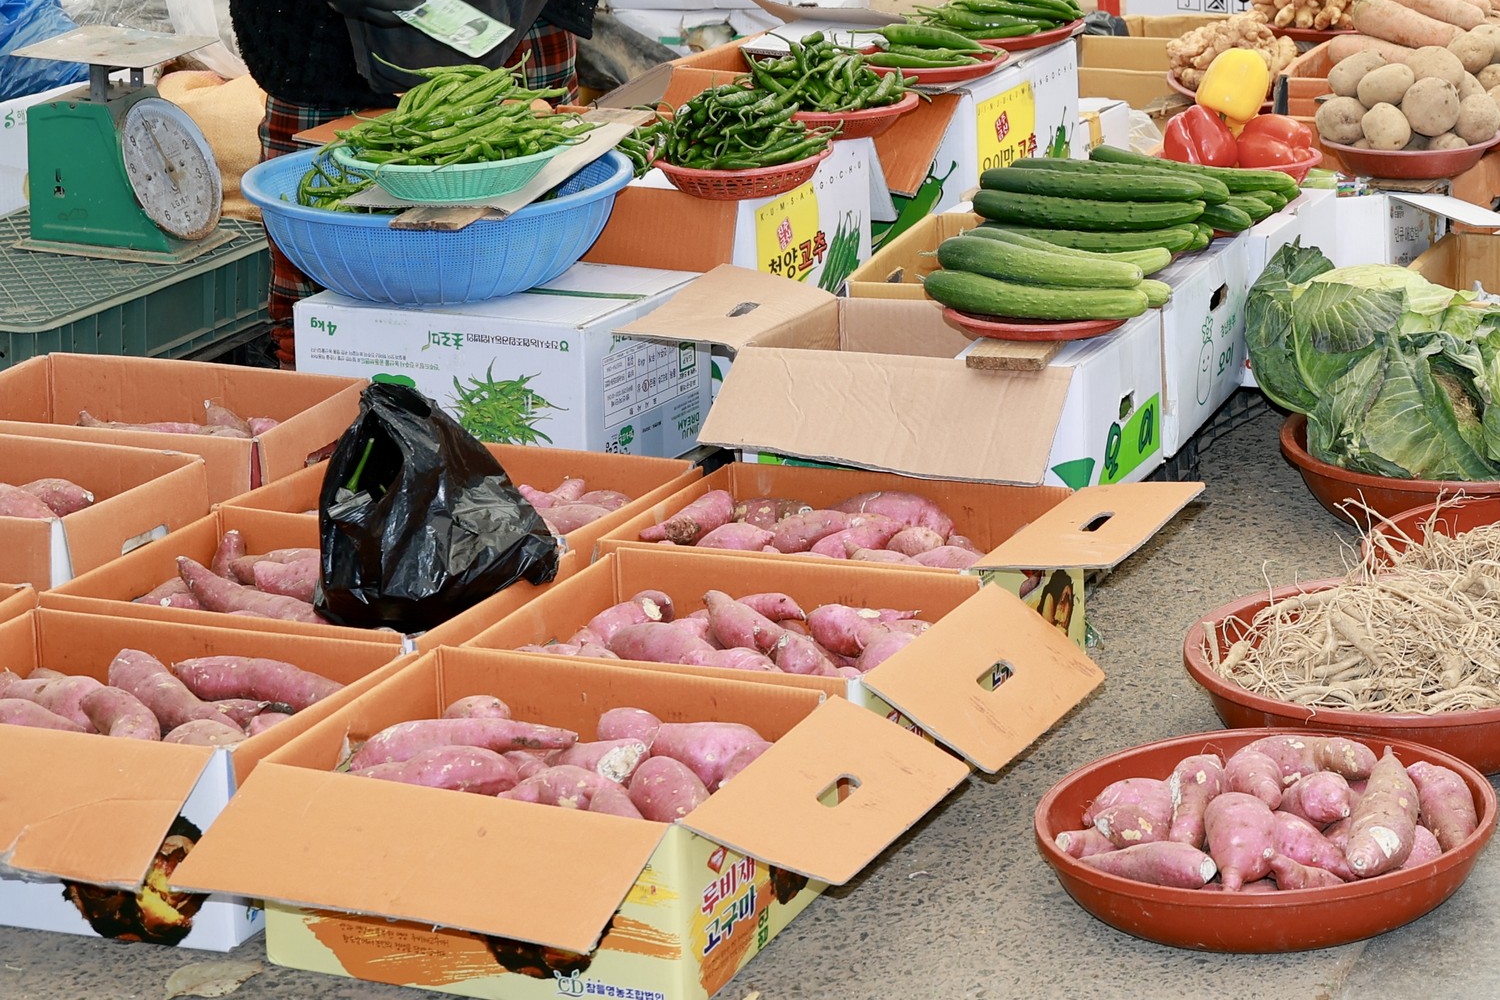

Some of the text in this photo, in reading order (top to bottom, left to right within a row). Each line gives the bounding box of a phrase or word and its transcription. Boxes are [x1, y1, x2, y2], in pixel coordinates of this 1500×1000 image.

[181, 139, 190, 151] 2
[129, 163, 137, 174] 8
[164, 210, 172, 221] 6
[184, 211, 191, 222] 5
[703, 884, 757, 955] 고구마
